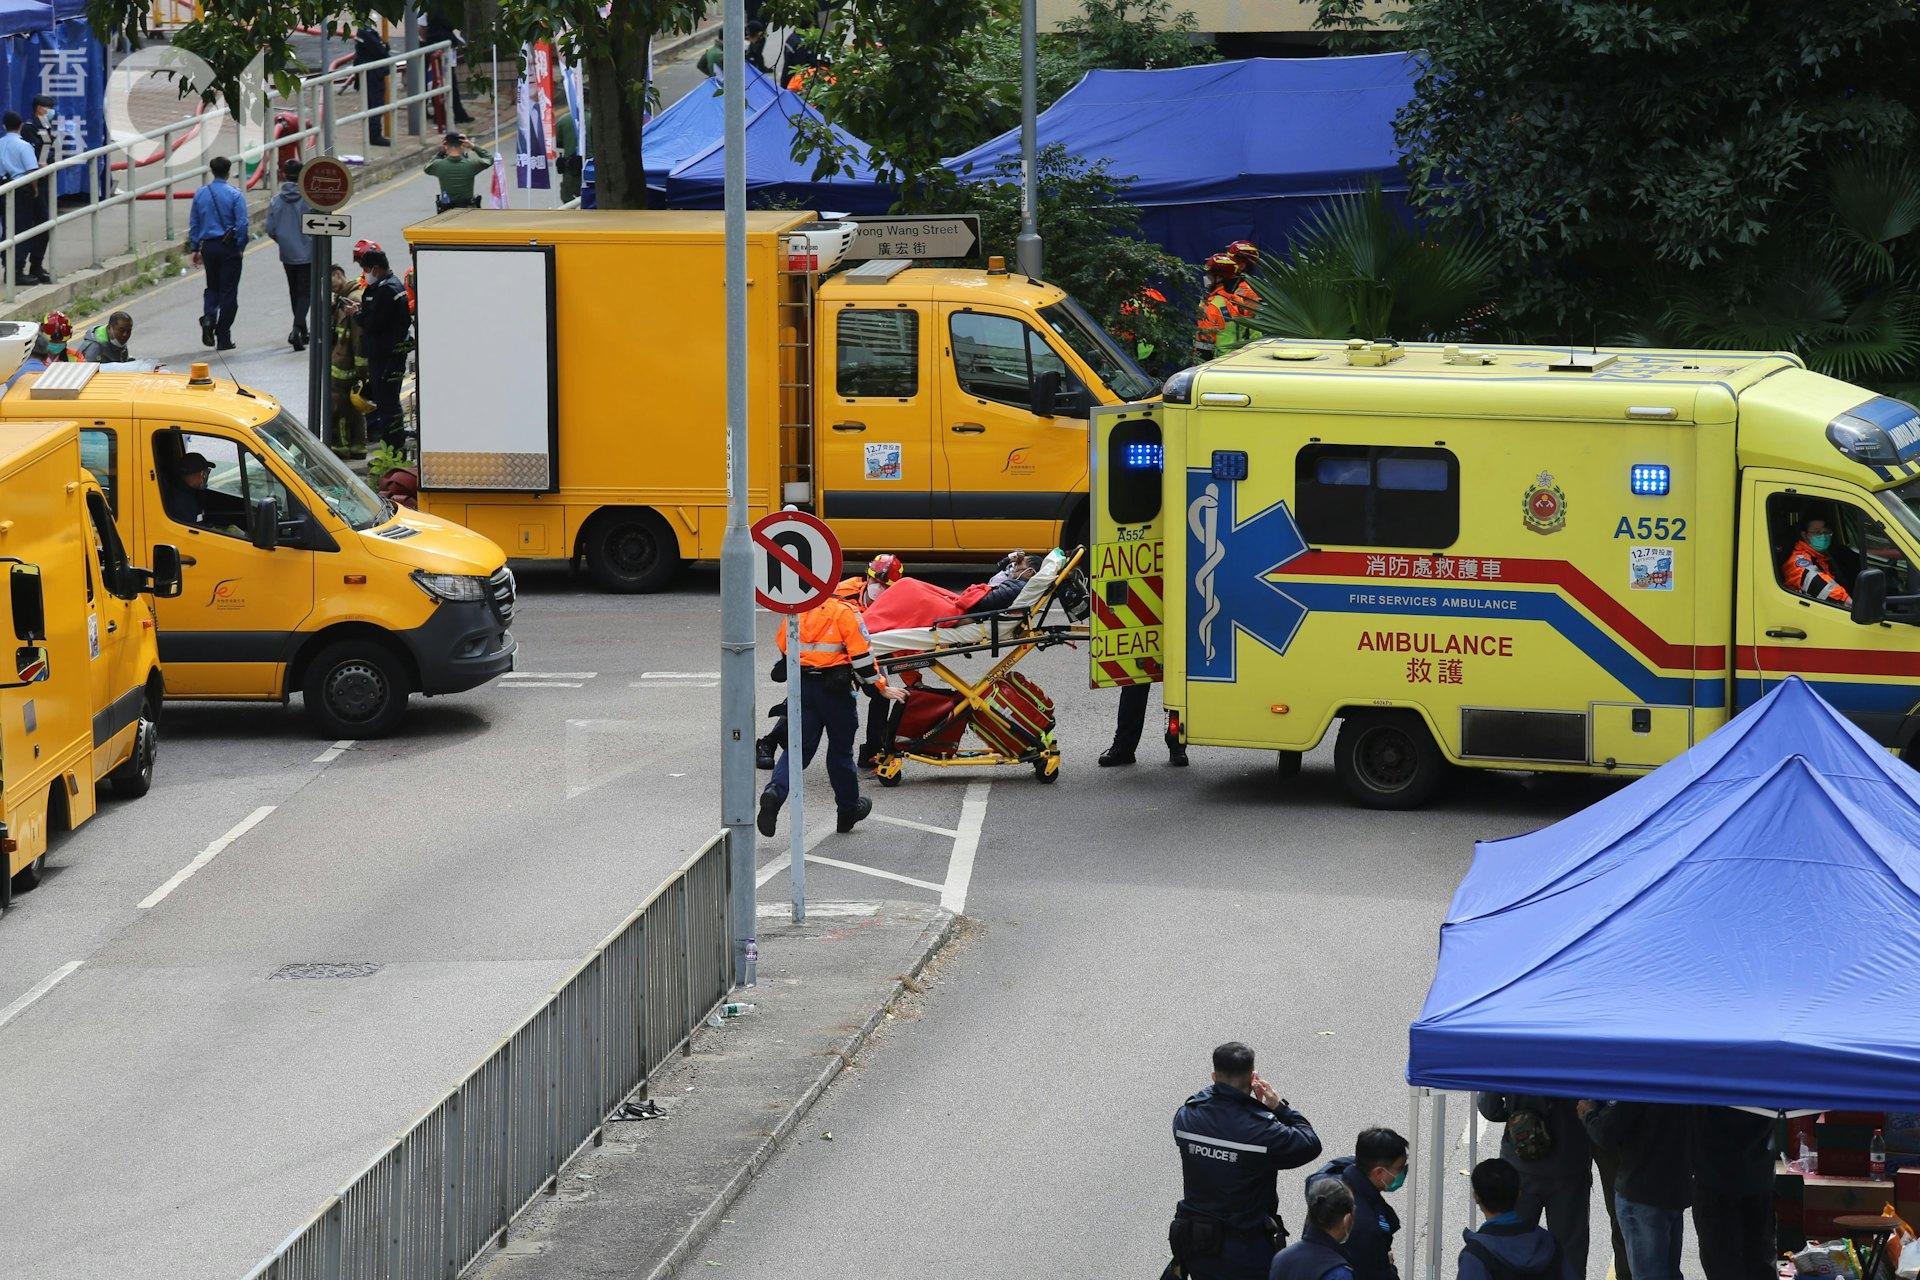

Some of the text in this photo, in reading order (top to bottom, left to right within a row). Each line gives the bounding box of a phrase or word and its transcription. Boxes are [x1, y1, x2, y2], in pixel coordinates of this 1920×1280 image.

[886, 225, 919, 237] Wang
[922, 224, 959, 235] Street
[878, 242, 927, 256] 廣宏街
[1117, 528, 1146, 542] A552
[1613, 515, 1687, 541] A552
[1631, 547, 1651, 559] 12.7
[1365, 554, 1502, 580] 消防處救護車
[1349, 594, 1517, 610] FIRE SERVICES AMBULANCE
[1091, 630, 1160, 659] CLEAR
[1357, 631, 1513, 657] AMBULANCE
[1406, 657, 1463, 685] 救護
[1195, 1145, 1229, 1161] POLICE
